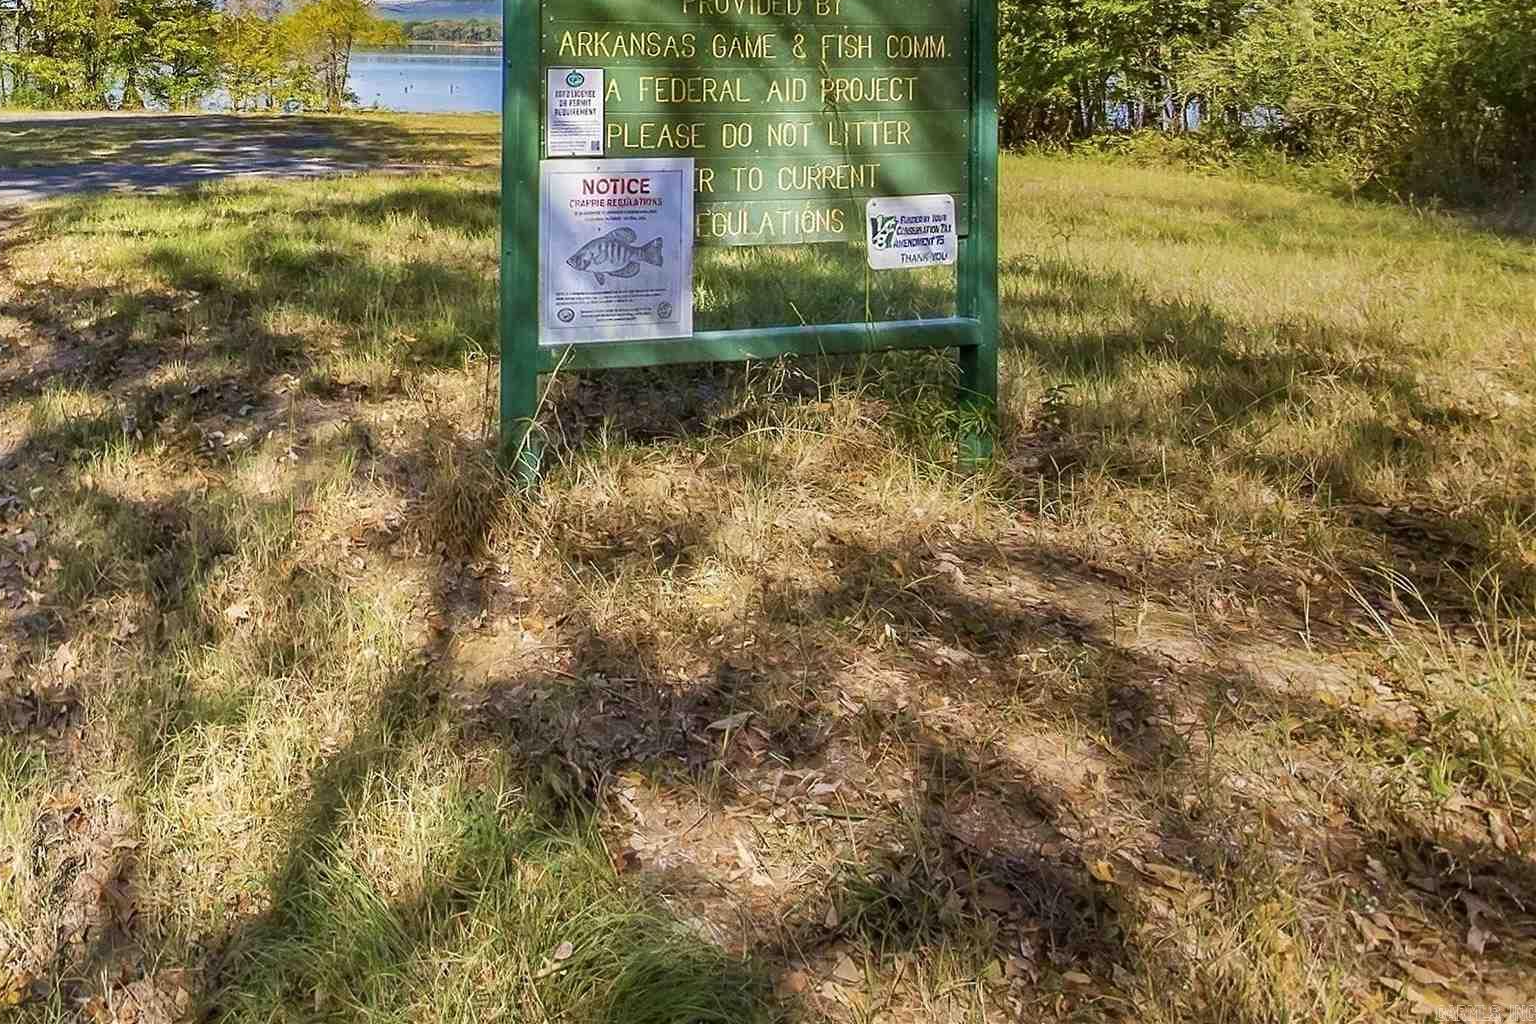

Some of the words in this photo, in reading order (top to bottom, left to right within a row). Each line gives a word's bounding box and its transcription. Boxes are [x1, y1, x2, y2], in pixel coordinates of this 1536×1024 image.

[559, 31, 696, 58] ARKANSAS
[712, 33, 776, 59] GAME
[792, 33, 807, 59] &
[821, 34, 872, 60] FISH
[886, 34, 952, 59] COMM.
[605, 78, 622, 102] A
[639, 77, 751, 103] FEDERAL
[766, 78, 807, 103] AID
[821, 77, 918, 103] PROJECT
[607, 123, 705, 149] PLEASE
[722, 123, 752, 148] DO
[767, 123, 814, 147] NOT
[828, 120, 911, 145] LITTER
[582, 178, 650, 195] NOTICE
[731, 166, 762, 192] TO
[778, 163, 880, 191] CURRENT
[569, 198, 605, 208] CRAPPIE
